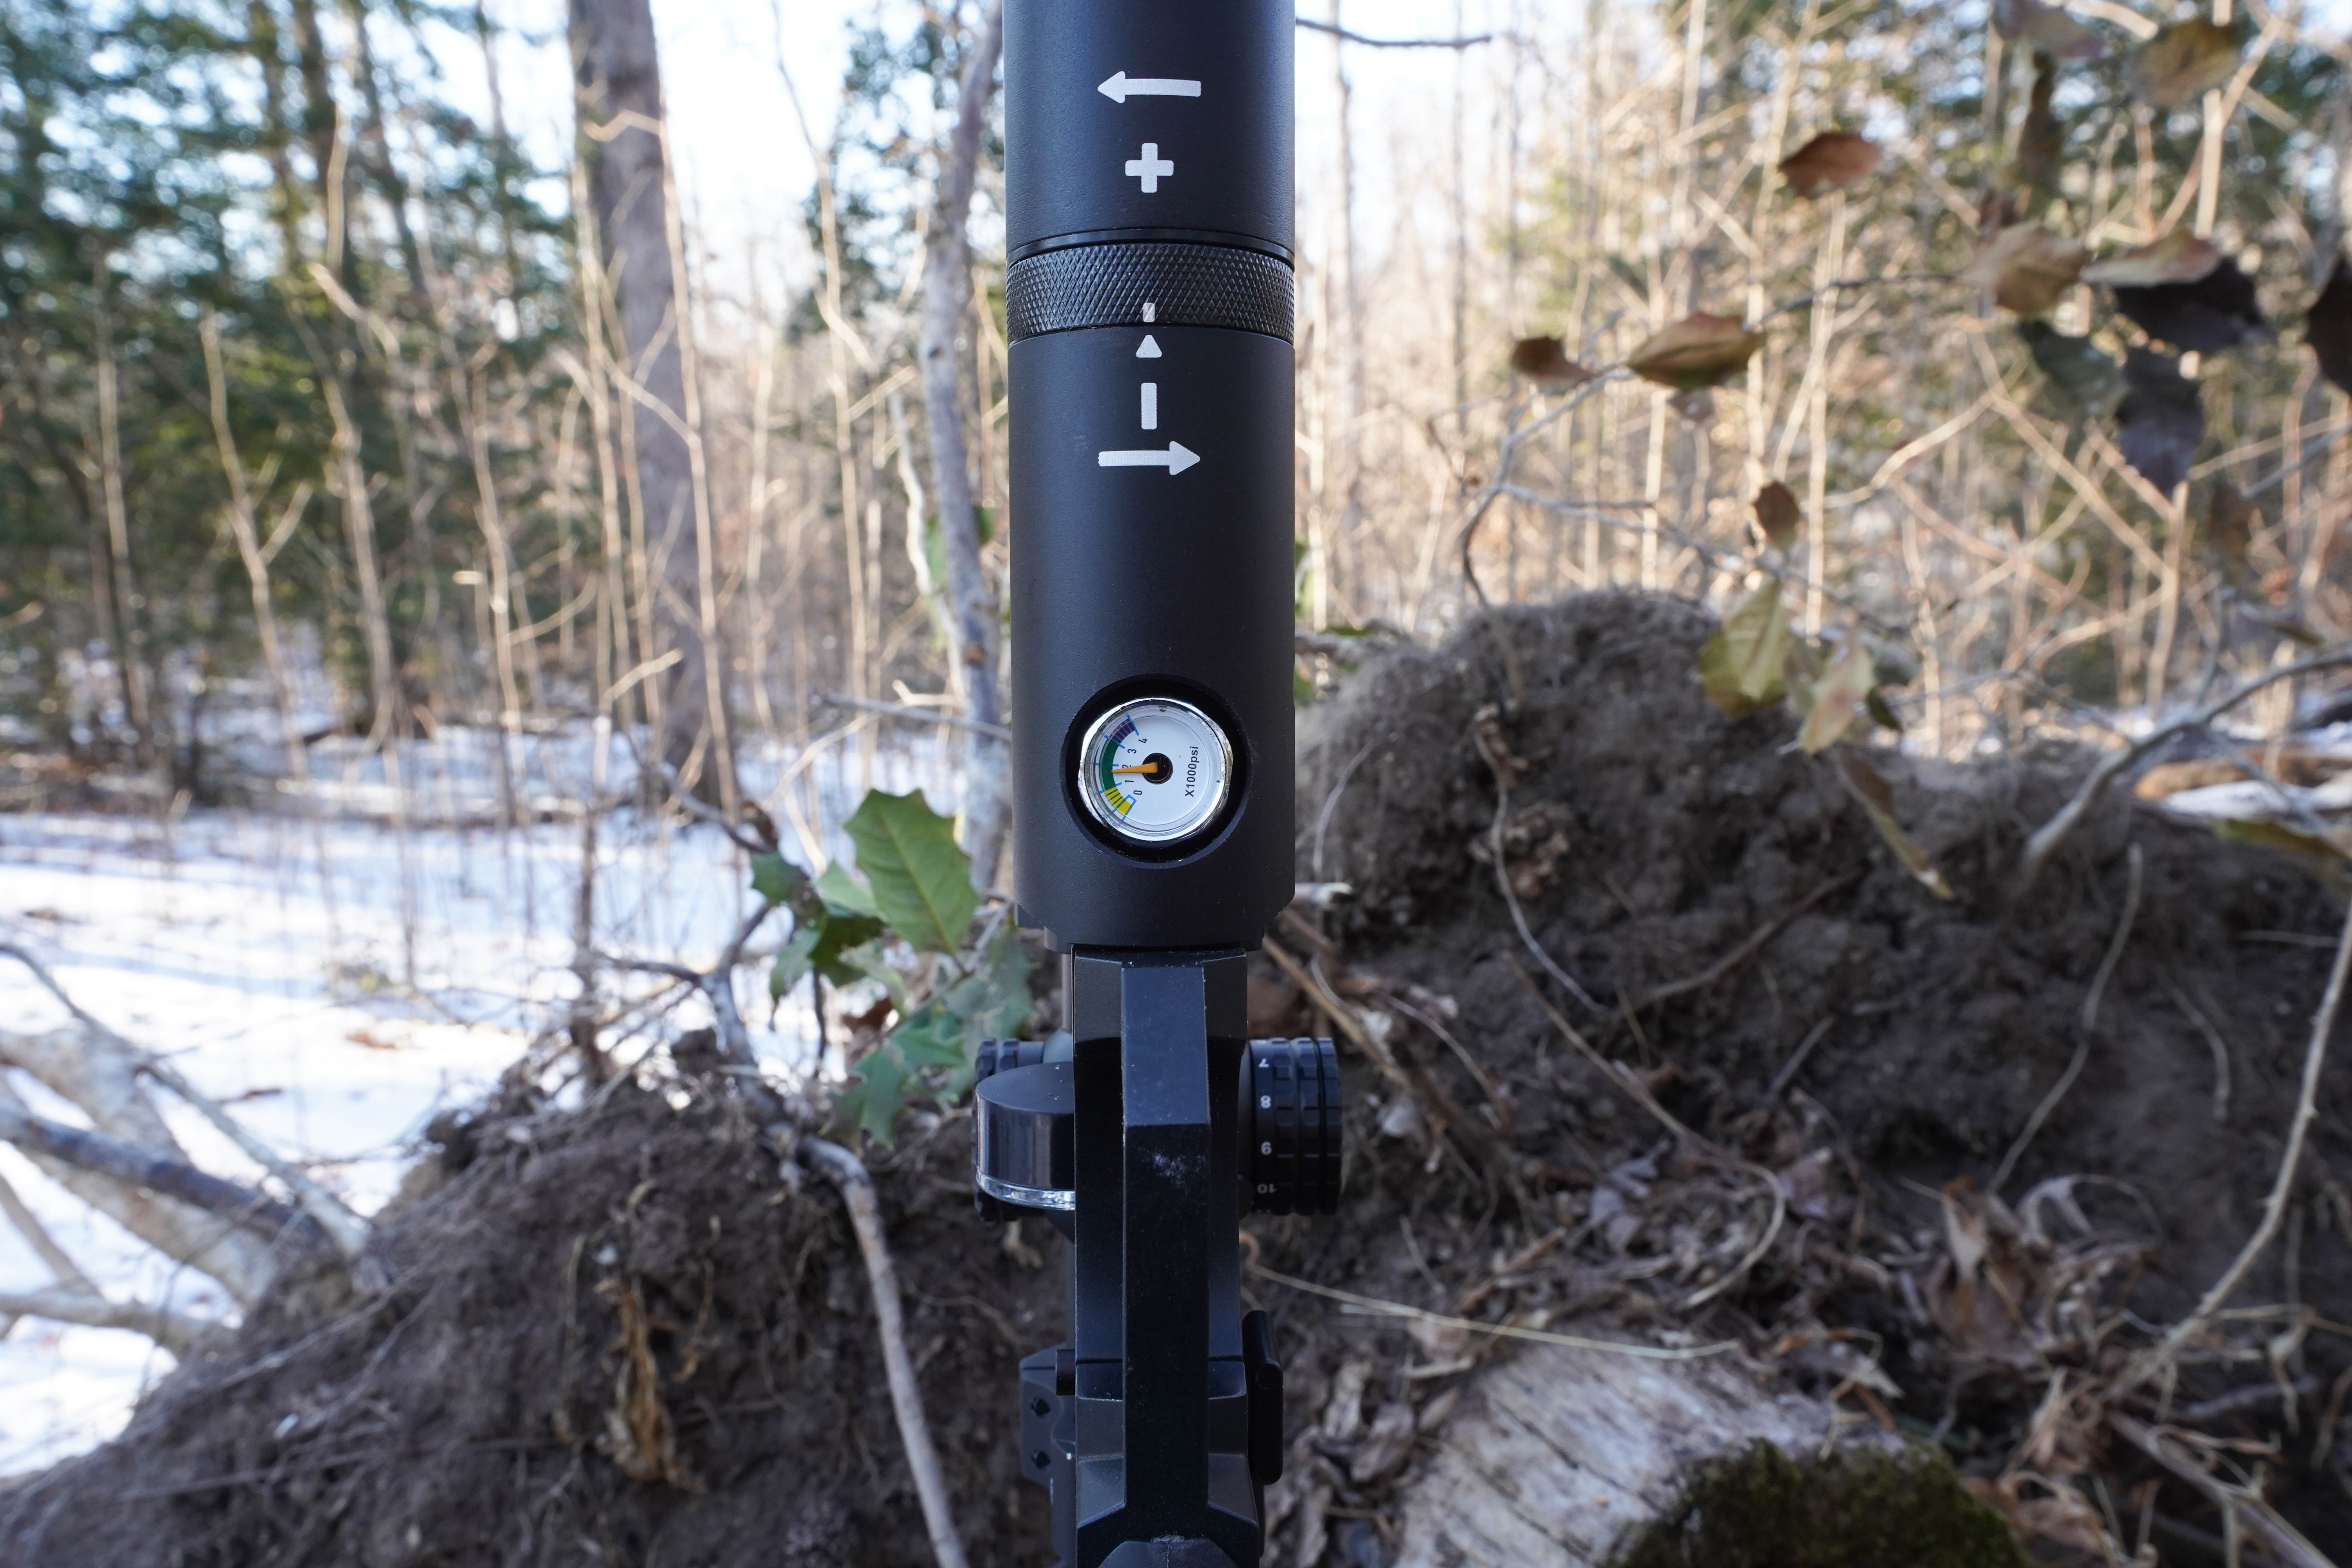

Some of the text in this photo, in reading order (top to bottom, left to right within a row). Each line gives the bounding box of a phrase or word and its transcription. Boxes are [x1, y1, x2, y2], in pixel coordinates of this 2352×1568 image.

[1185, 746, 1199, 797] X1000psi
[1258, 1058, 1270, 1068] 7
[1260, 1095, 1271, 1109] 8
[1257, 1183, 1277, 1194] 10
